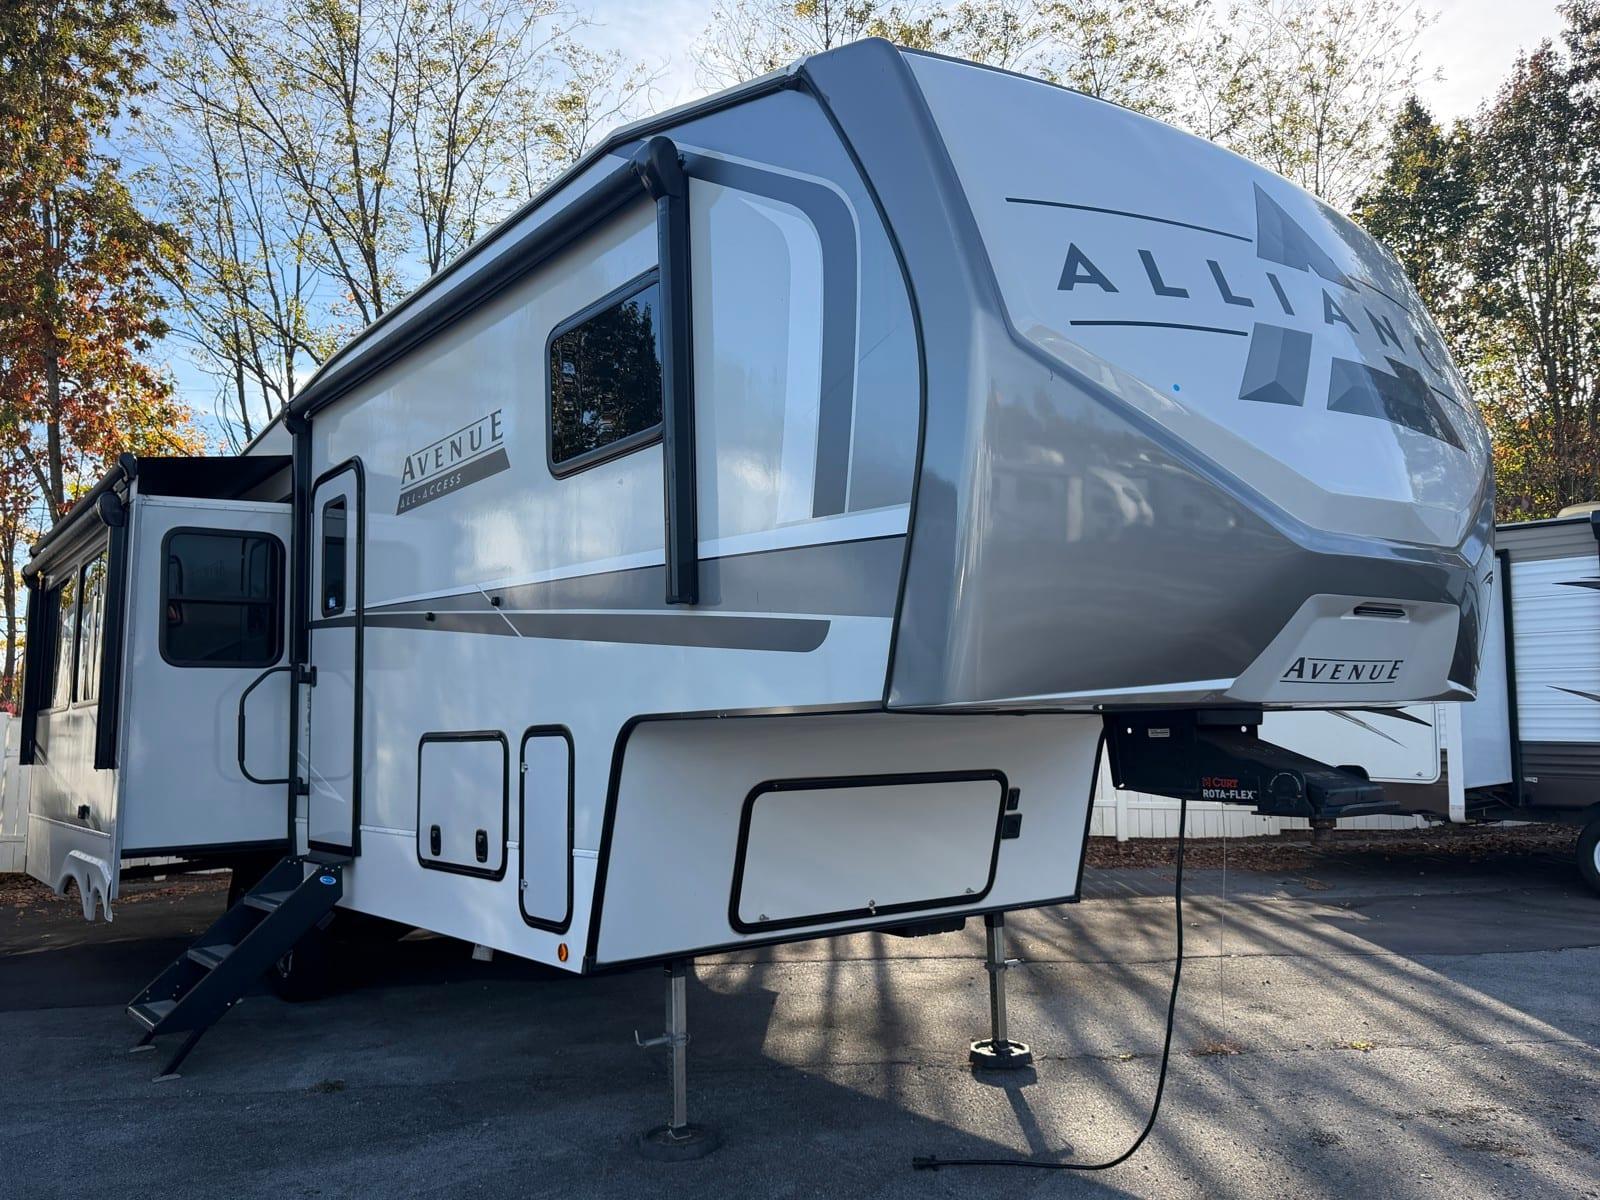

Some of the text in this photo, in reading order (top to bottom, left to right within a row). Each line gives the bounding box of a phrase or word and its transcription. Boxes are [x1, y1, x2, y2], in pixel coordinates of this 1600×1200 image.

[1057, 242, 1442, 378] ALLIANC
[402, 409, 504, 485] AVENUE
[400, 473, 462, 508] ALL-ACCESS
[1283, 656, 1404, 680] AVENUE
[1202, 789, 1254, 800] ROTA-FLEX
